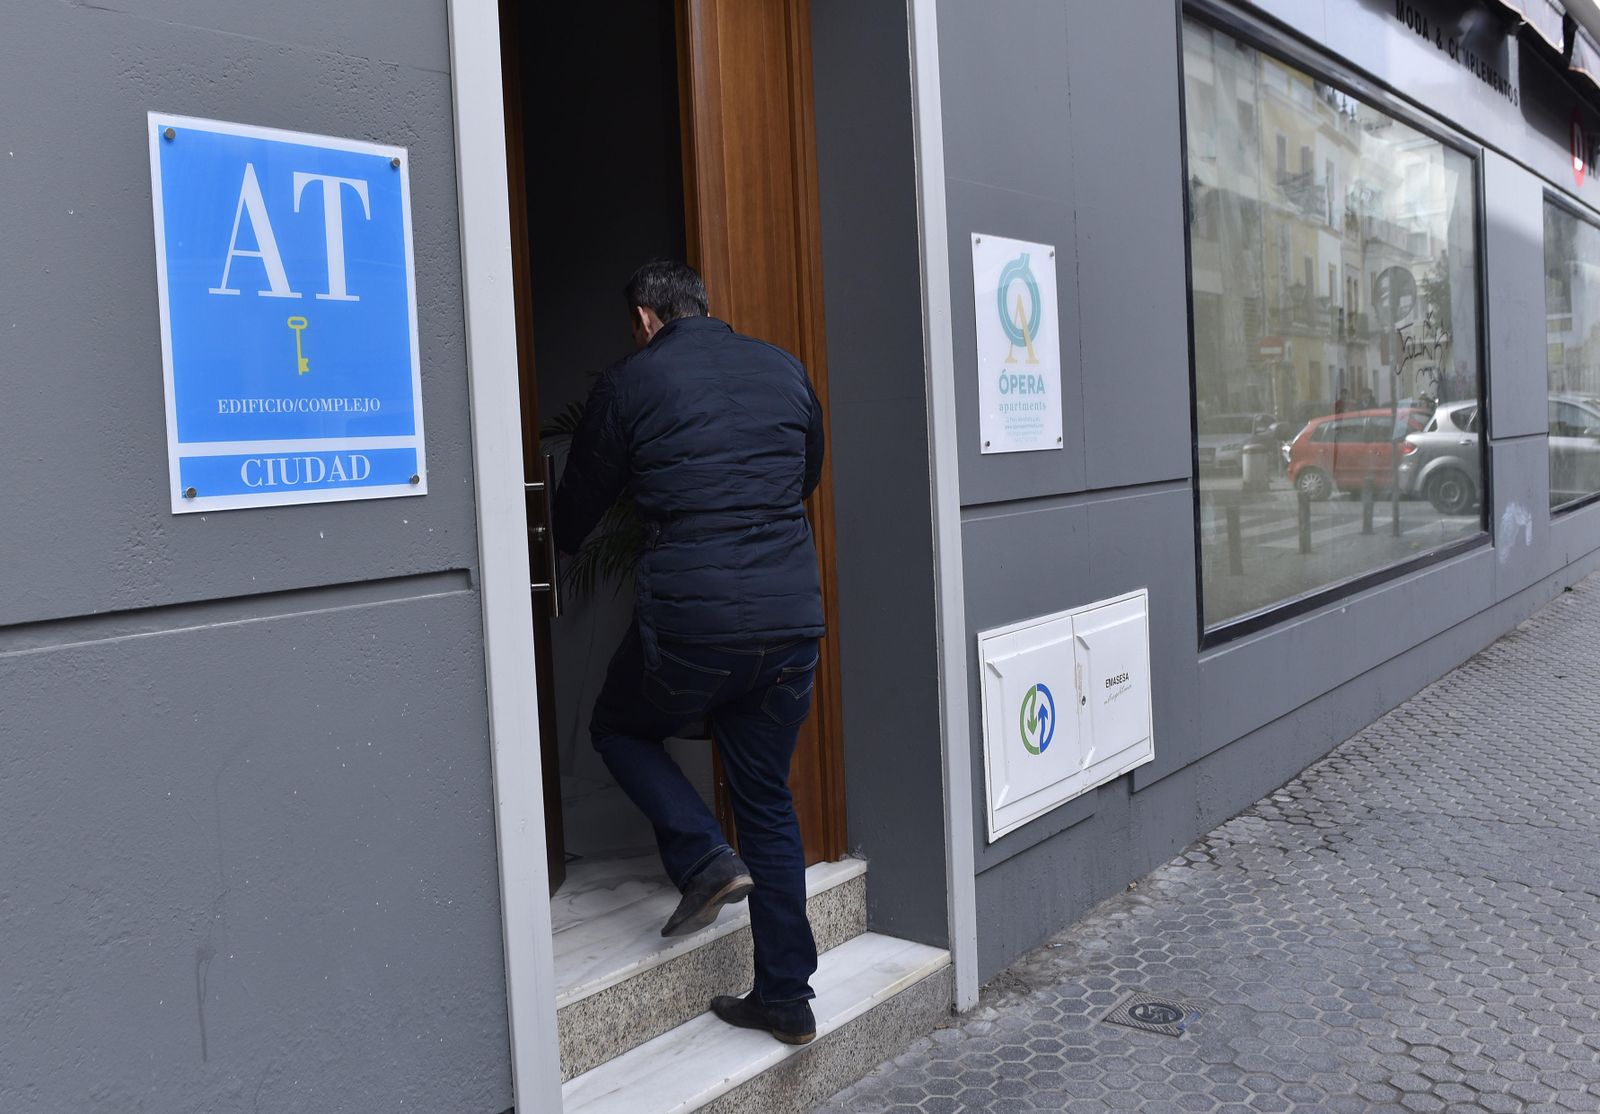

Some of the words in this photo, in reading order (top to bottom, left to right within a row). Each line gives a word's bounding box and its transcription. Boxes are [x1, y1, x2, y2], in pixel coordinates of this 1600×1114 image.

[1396, 0, 1430, 42] MODA
[208, 162, 371, 302] AT
[999, 368, 1046, 395] ÓPERA
[217, 398, 381, 414] EDIFICIO/COMPLEJO
[999, 401, 1047, 414] apartments
[240, 454, 371, 488] CIUDAD
[1105, 672, 1130, 689] EMASESA
